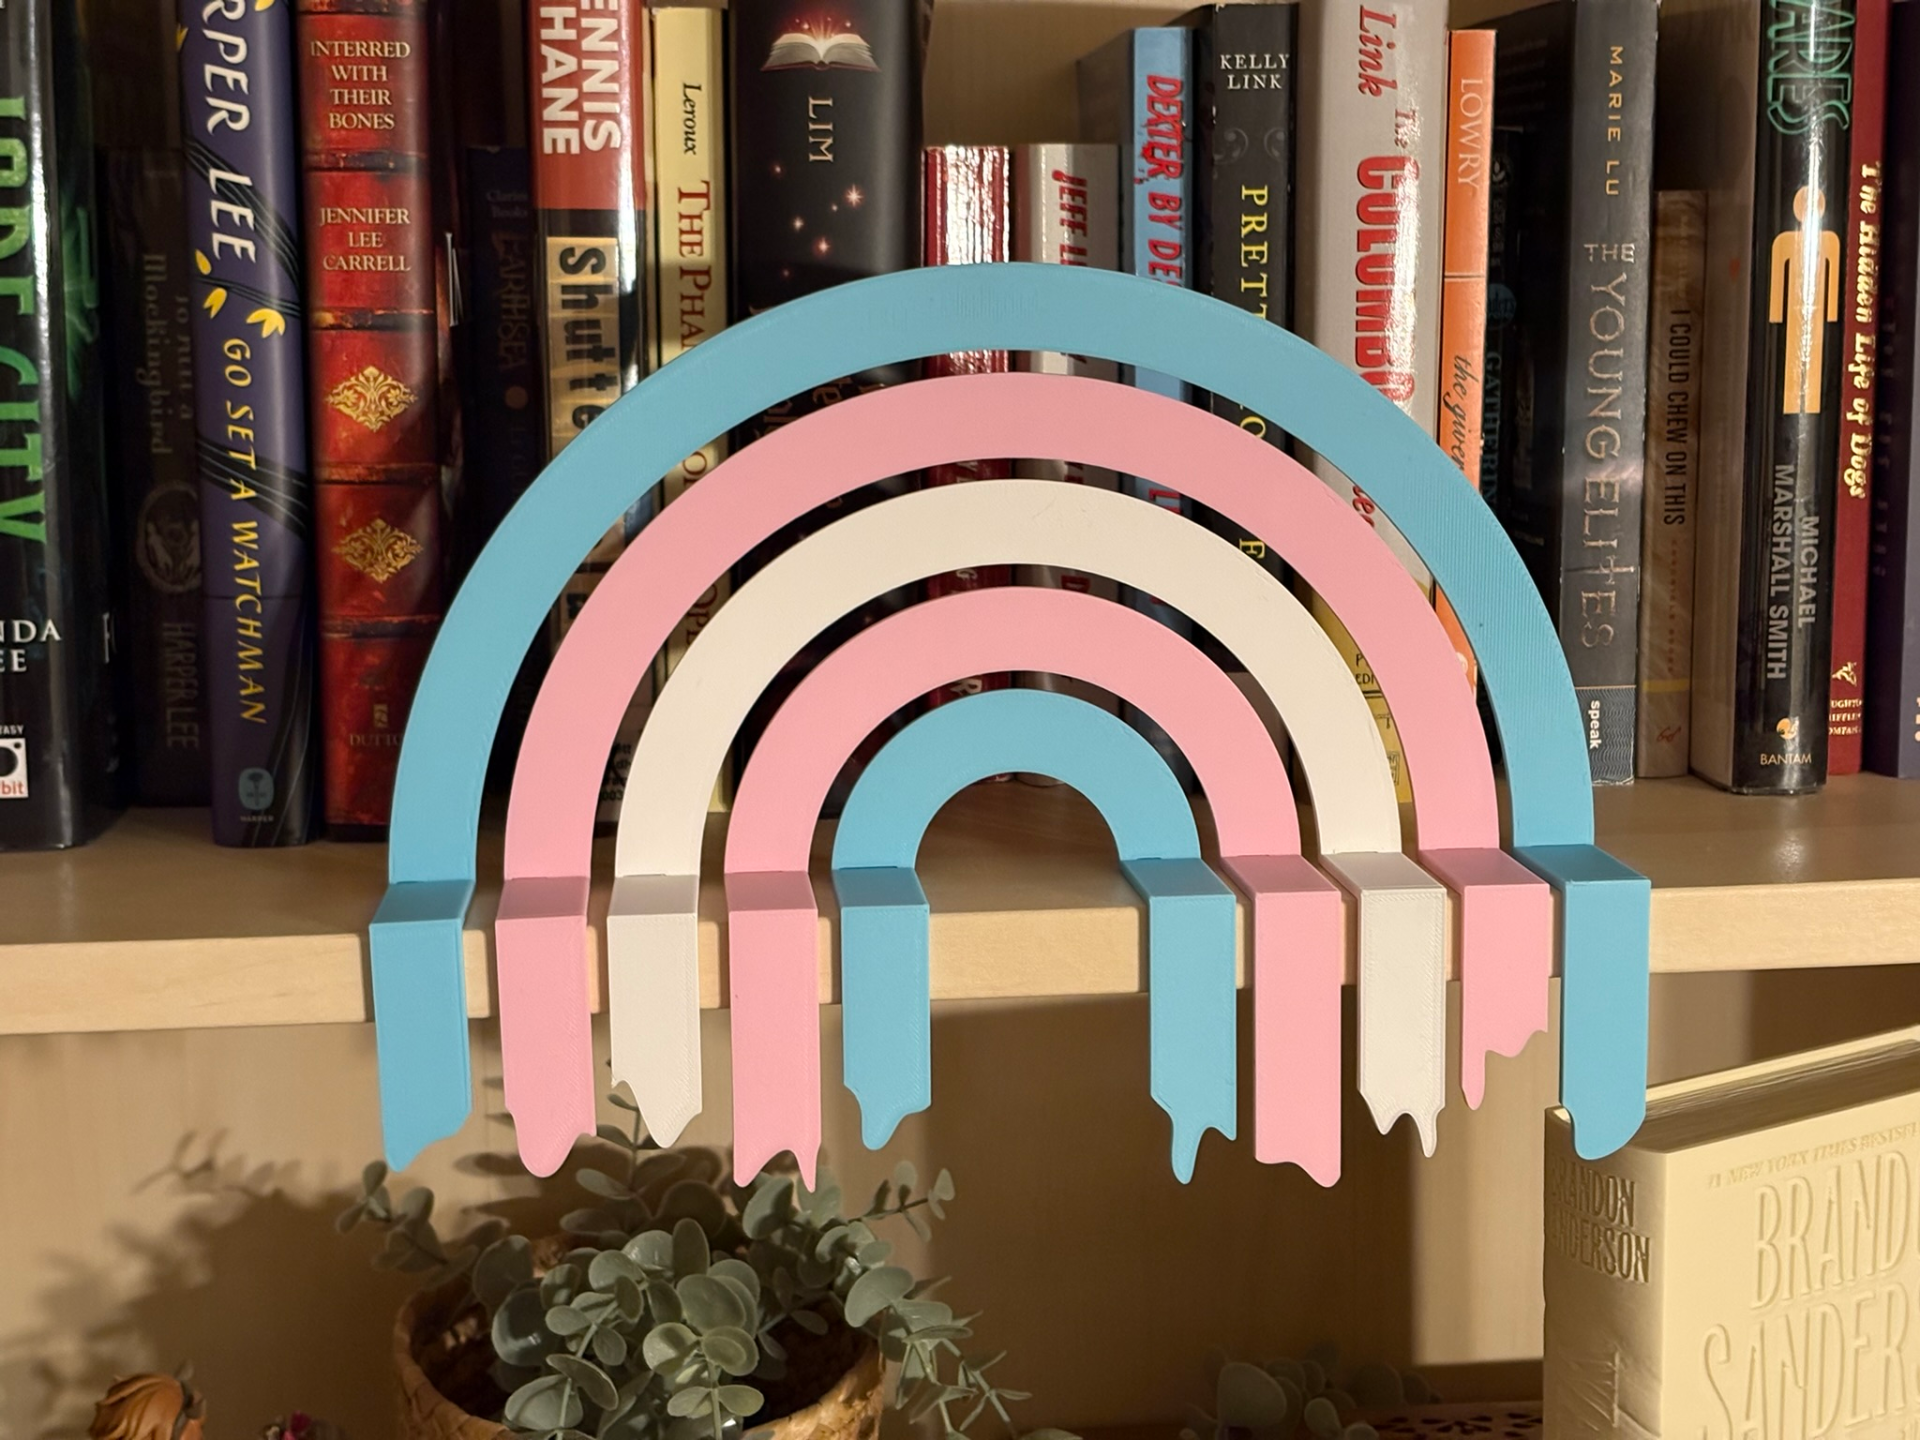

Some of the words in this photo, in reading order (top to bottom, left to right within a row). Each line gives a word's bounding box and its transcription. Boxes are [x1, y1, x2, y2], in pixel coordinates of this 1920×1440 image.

[310, 40, 412, 59] INTERRED
[331, 65, 389, 83] WITH
[1220, 53, 1290, 71] KELLY
[1358, 5, 1398, 97] Link
[330, 88, 393, 107] THEIR
[540, 6, 581, 155] HANE
[1227, 74, 1282, 90] LINK
[1607, 45, 1624, 142] MARIE
[328, 112, 396, 131] BONES
[682, 82, 702, 155] Leroux
[807, 96, 834, 163] LIM
[1146, 74, 1184, 180] DEXTER
[1457, 77, 1485, 197] LOWRY
[1051, 169, 1088, 237] JEFF
[1605, 160, 1621, 196] LU
[1858, 160, 1884, 216] The
[208, 167, 257, 264] LEE
[319, 207, 412, 227] JENNIFER
[347, 231, 384, 249] LEE
[677, 180, 711, 258] THE
[1147, 192, 1183, 231] BY
[322, 254, 412, 273] CARRELL
[1583, 243, 1636, 264] THE
[1854, 220, 1882, 324] Hidden
[1671, 308, 1692, 316] I
[135, 253, 174, 456] Mockingbird
[223, 337, 253, 389] GO
[1452, 354, 1479, 401] the
[1584, 272, 1628, 462] YOUNG
[1668, 323, 1692, 384] COULD
[1847, 332, 1878, 391] Life
[226, 400, 257, 470] SET
[1665, 391, 1690, 444] CHEW
[1846, 396, 1873, 426] of
[229, 478, 258, 502] A
[1664, 451, 1688, 476] ON
[1843, 432, 1874, 500] Dogs
[1663, 484, 1687, 526] THIS
[1770, 462, 1796, 597] MARSHALL
[1797, 514, 1821, 630] MICHAEL
[229, 519, 269, 725] WATCHMAN
[1765, 603, 1789, 681] SMITH
[161, 622, 197, 704] HARPER
[164, 705, 199, 751] LEE
[1587, 699, 1602, 751] speak
[1759, 752, 1814, 766] BANTAM
[1749, 1149, 1920, 1312] BRAND
[1698, 1281, 1920, 1440] SANDER
